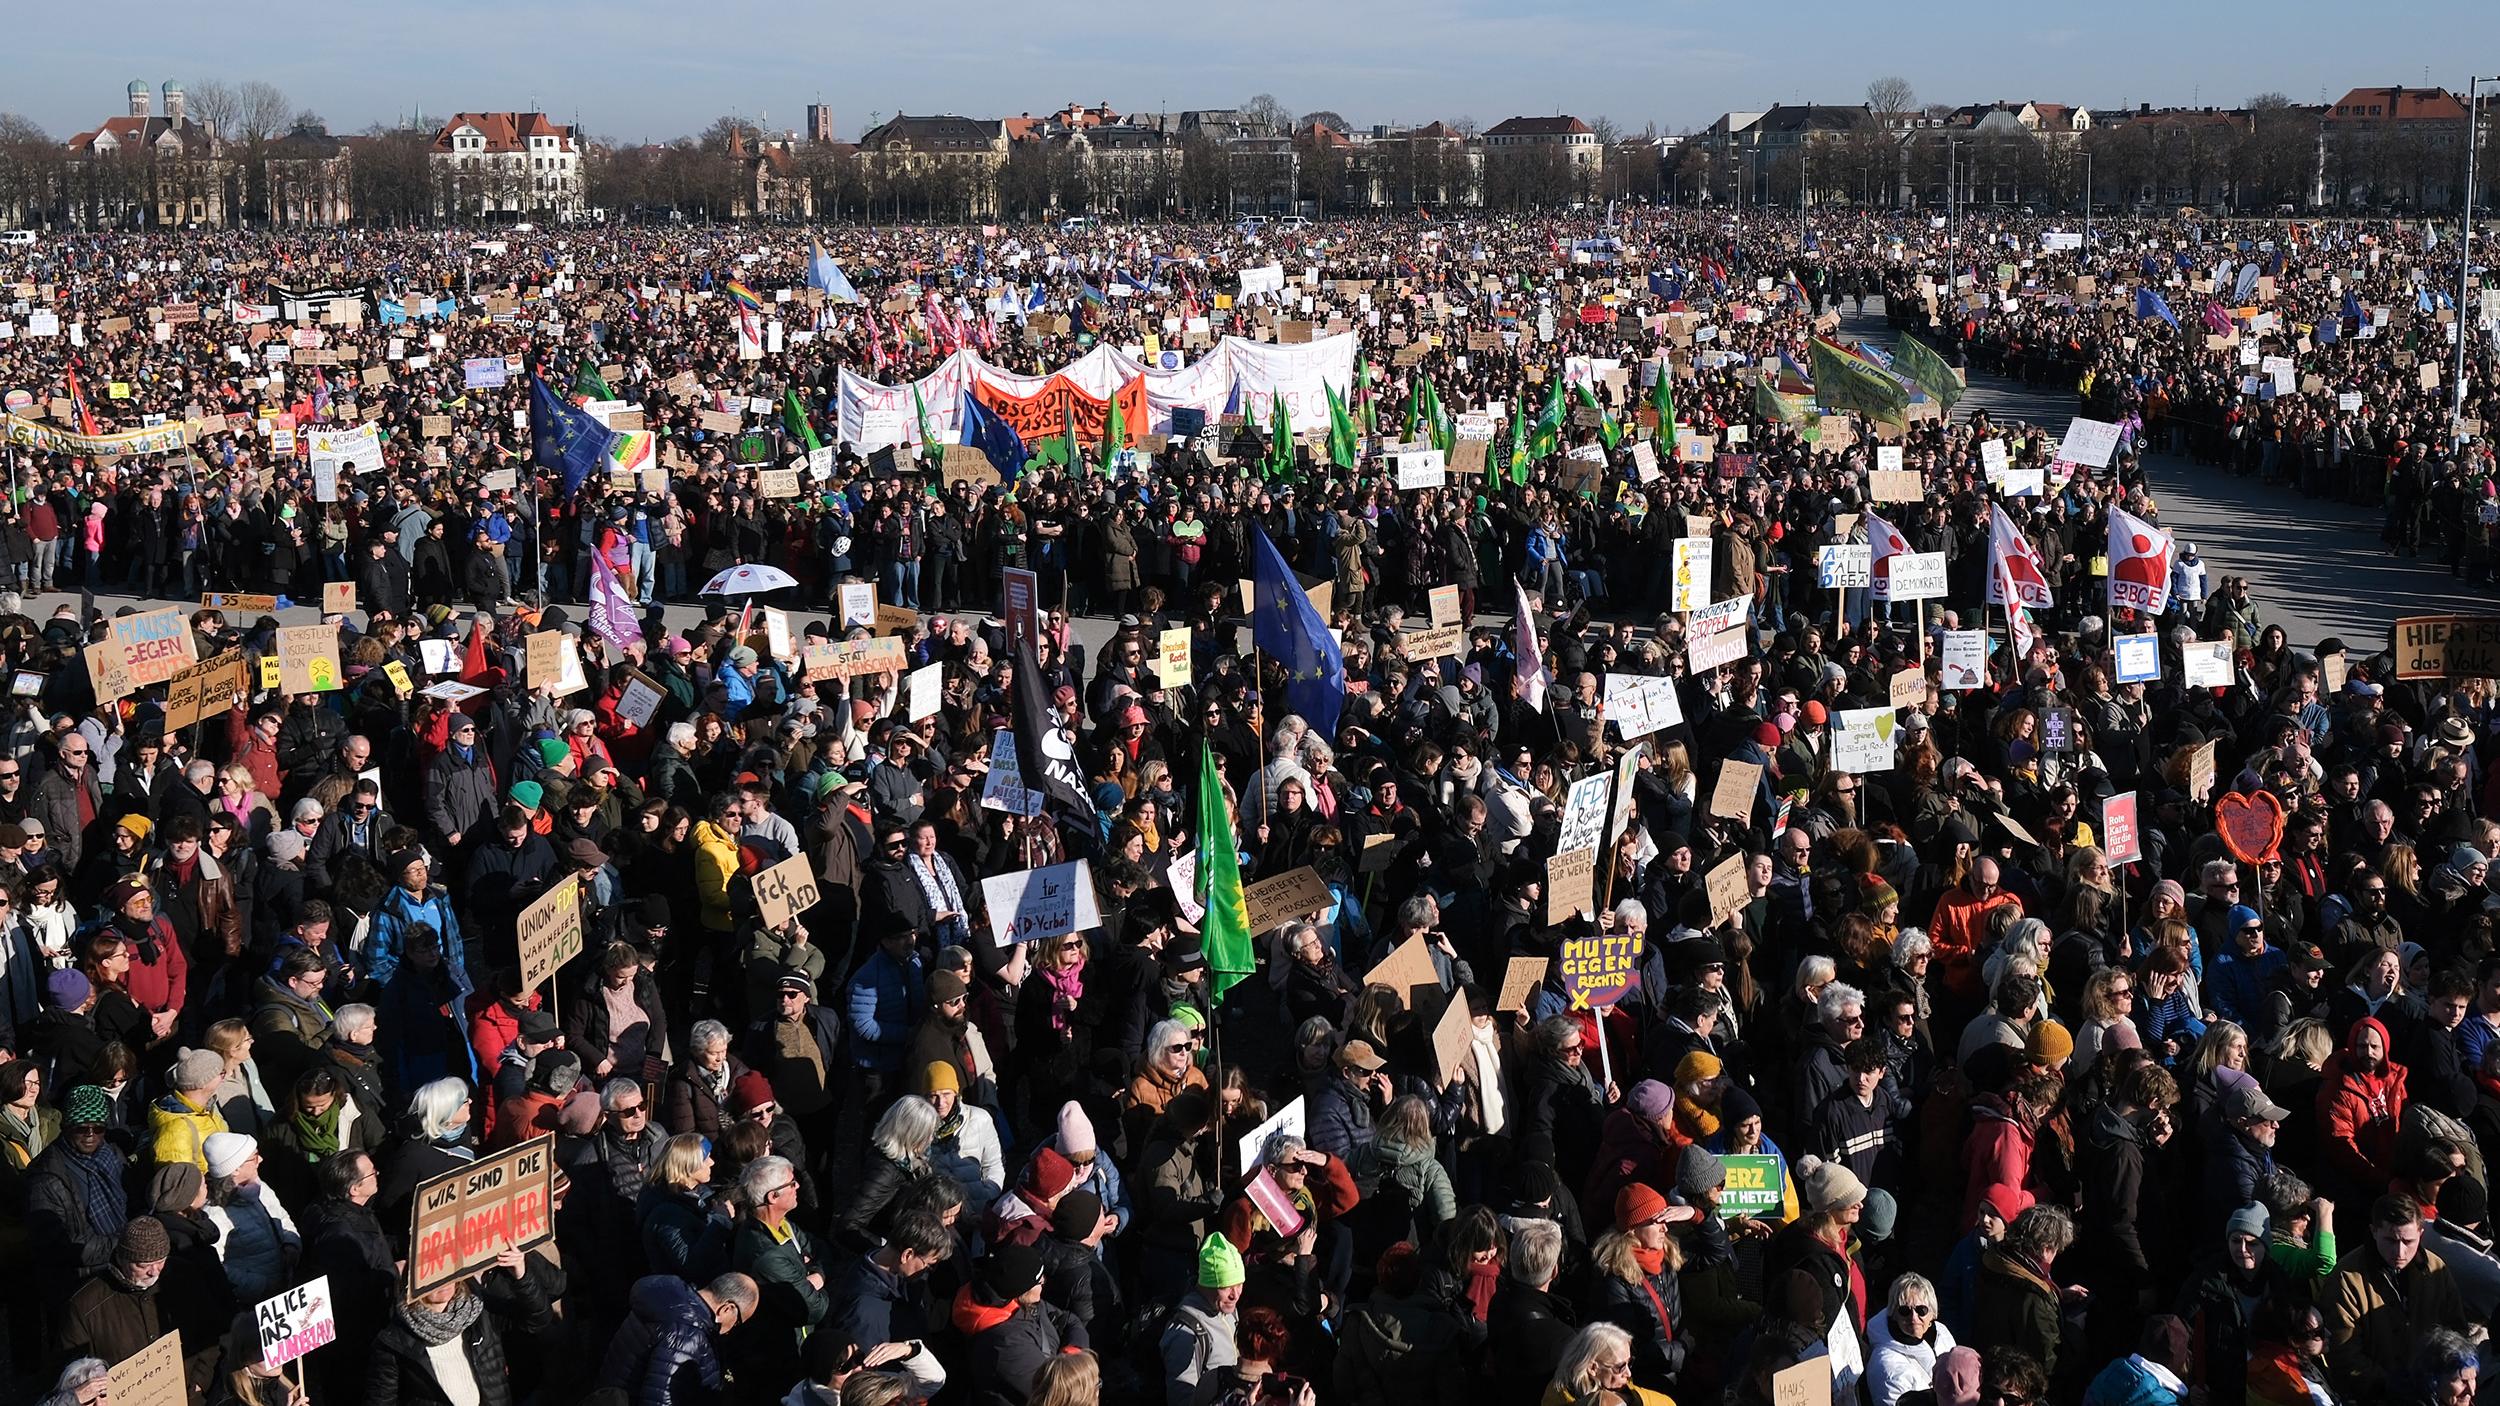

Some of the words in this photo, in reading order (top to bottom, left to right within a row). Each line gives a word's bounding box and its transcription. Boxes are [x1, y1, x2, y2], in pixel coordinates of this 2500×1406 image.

[1894, 560, 1916, 573] WIR
[1917, 557, 1940, 571] SIND
[1895, 576, 1945, 592] DEMOKRATIE
[203, 594, 239, 607] HASS
[2114, 583, 2127, 600] IG
[2127, 583, 2162, 609] BCE
[1691, 598, 1740, 622] FASCHISMUS
[1690, 616, 1729, 640] STOPPEN
[2406, 623, 2465, 647] HIER
[126, 636, 183, 666] GEGEN
[838, 650, 867, 664] STATT
[2411, 649, 2441, 671] das
[2447, 648, 2495, 671] Volk
[128, 654, 193, 685] RECHTS
[191, 659, 220, 679] JESUS
[2045, 737, 2066, 749] JETZT
[992, 785, 1036, 801] NICHT
[2108, 814, 2125, 826] Rote
[2109, 824, 2129, 837] Karte
[2109, 834, 2121, 846] für
[2120, 832, 2132, 844] die
[2110, 843, 2126, 857] AfD!
[1548, 848, 1592, 872] SICHERHEIT
[1042, 877, 1061, 898] für
[1549, 869, 1566, 884] FÜR
[556, 881, 579, 915] FDP
[786, 882, 818, 916] AfD
[1244, 873, 1310, 904] SCHENRECHTE
[1261, 889, 1291, 908] STATT
[1276, 893, 1327, 917] MENSCHEN
[523, 912, 576, 961] WAHLHELFER
[1003, 909, 1069, 942] AfD-Verbot
[526, 963, 546, 983] DER
[550, 928, 581, 970] AFD
[1562, 955, 1633, 976] GEGEN
[1577, 972, 1626, 990] RECHTS
[428, 1182, 457, 1212] WIR
[467, 1166, 504, 1197] SIND
[517, 1152, 542, 1178] DIE
[1725, 1167, 1766, 1190] ERZ
[1739, 1190, 1779, 1205] HETZE
[260, 1286, 308, 1328] ALICE
[261, 1320, 292, 1349] INS
[111, 1367, 130, 1385] Wer
[135, 1351, 152, 1369] hat
[156, 1340, 173, 1357] uns
[114, 1364, 162, 1402] verraten
